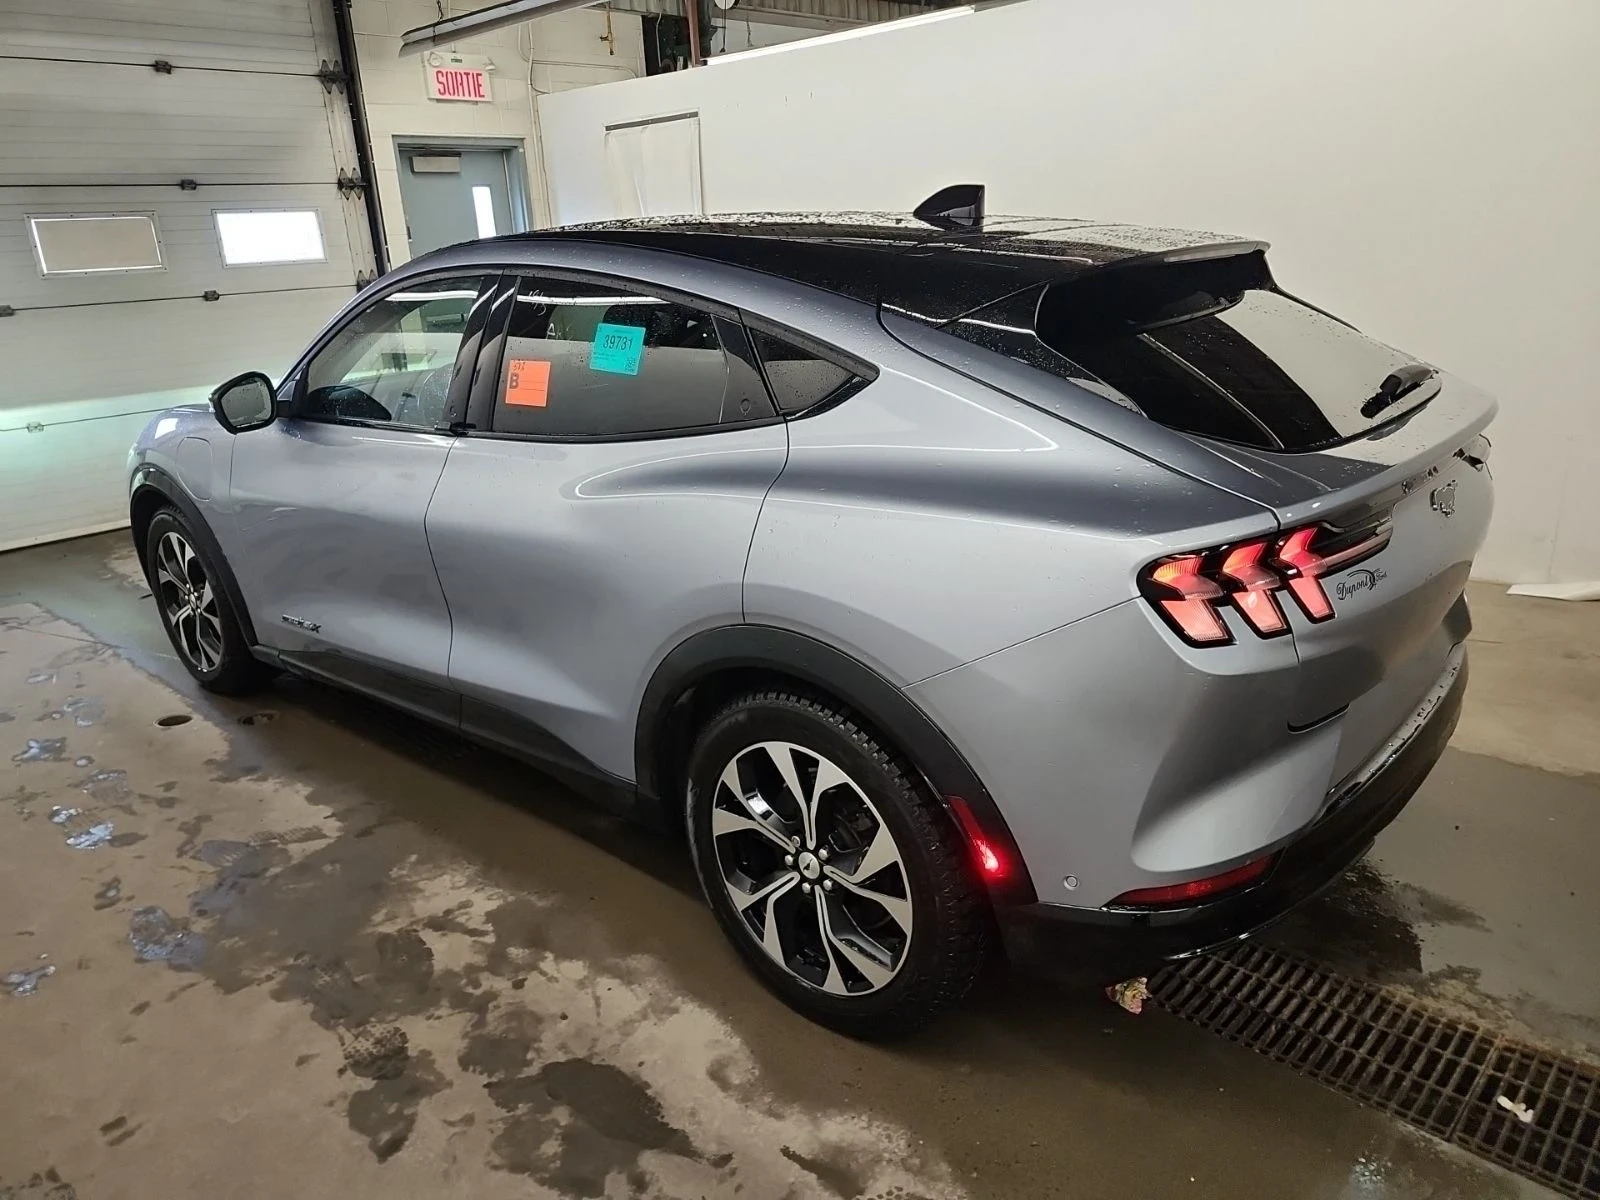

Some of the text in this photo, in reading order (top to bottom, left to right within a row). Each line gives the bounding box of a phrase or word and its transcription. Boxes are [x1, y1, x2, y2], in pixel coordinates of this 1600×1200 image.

[435, 70, 486, 98] SORTIE
[602, 334, 634, 351] 39731
[509, 372, 519, 389] B
